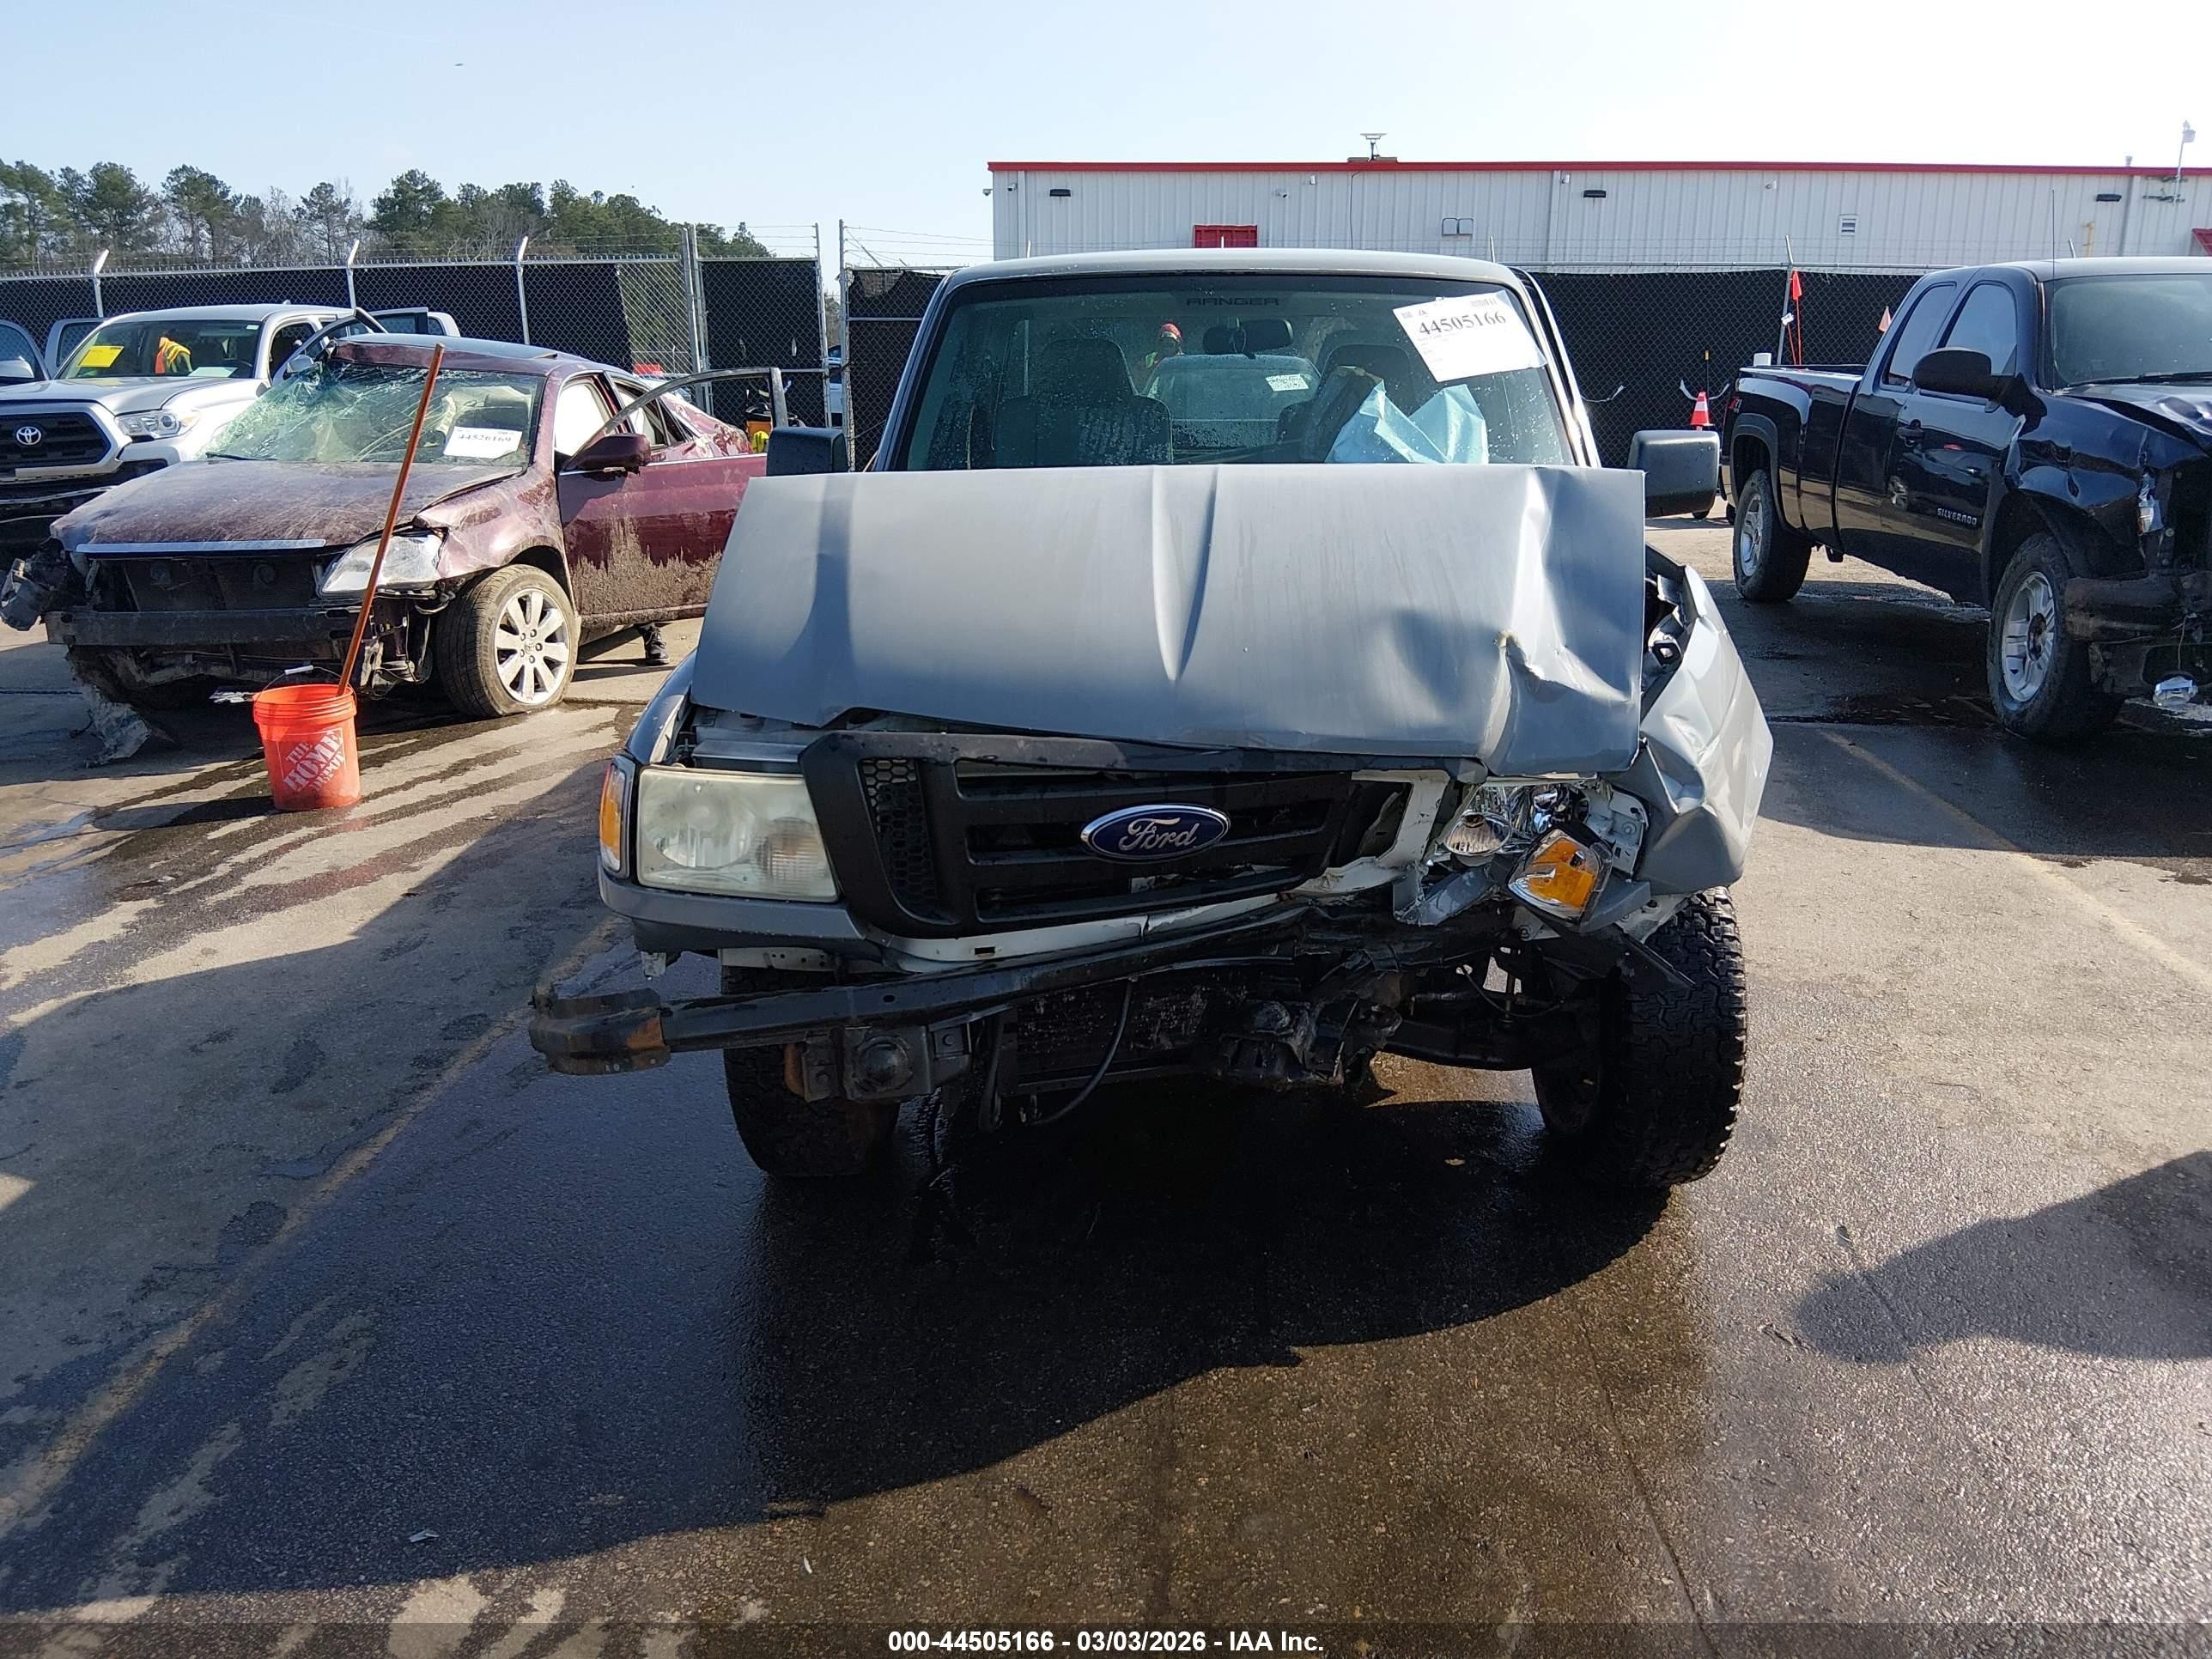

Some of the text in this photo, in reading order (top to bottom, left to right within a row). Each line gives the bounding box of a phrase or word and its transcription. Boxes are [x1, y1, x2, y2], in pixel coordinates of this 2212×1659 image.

[1186, 297, 1279, 306] RANGER
[1419, 311, 1506, 335] 44505166
[1937, 507, 1978, 525] SILVERADO
[283, 731, 341, 792] HOME
[286, 742, 313, 765] THE
[1118, 817, 1200, 851] Ford
